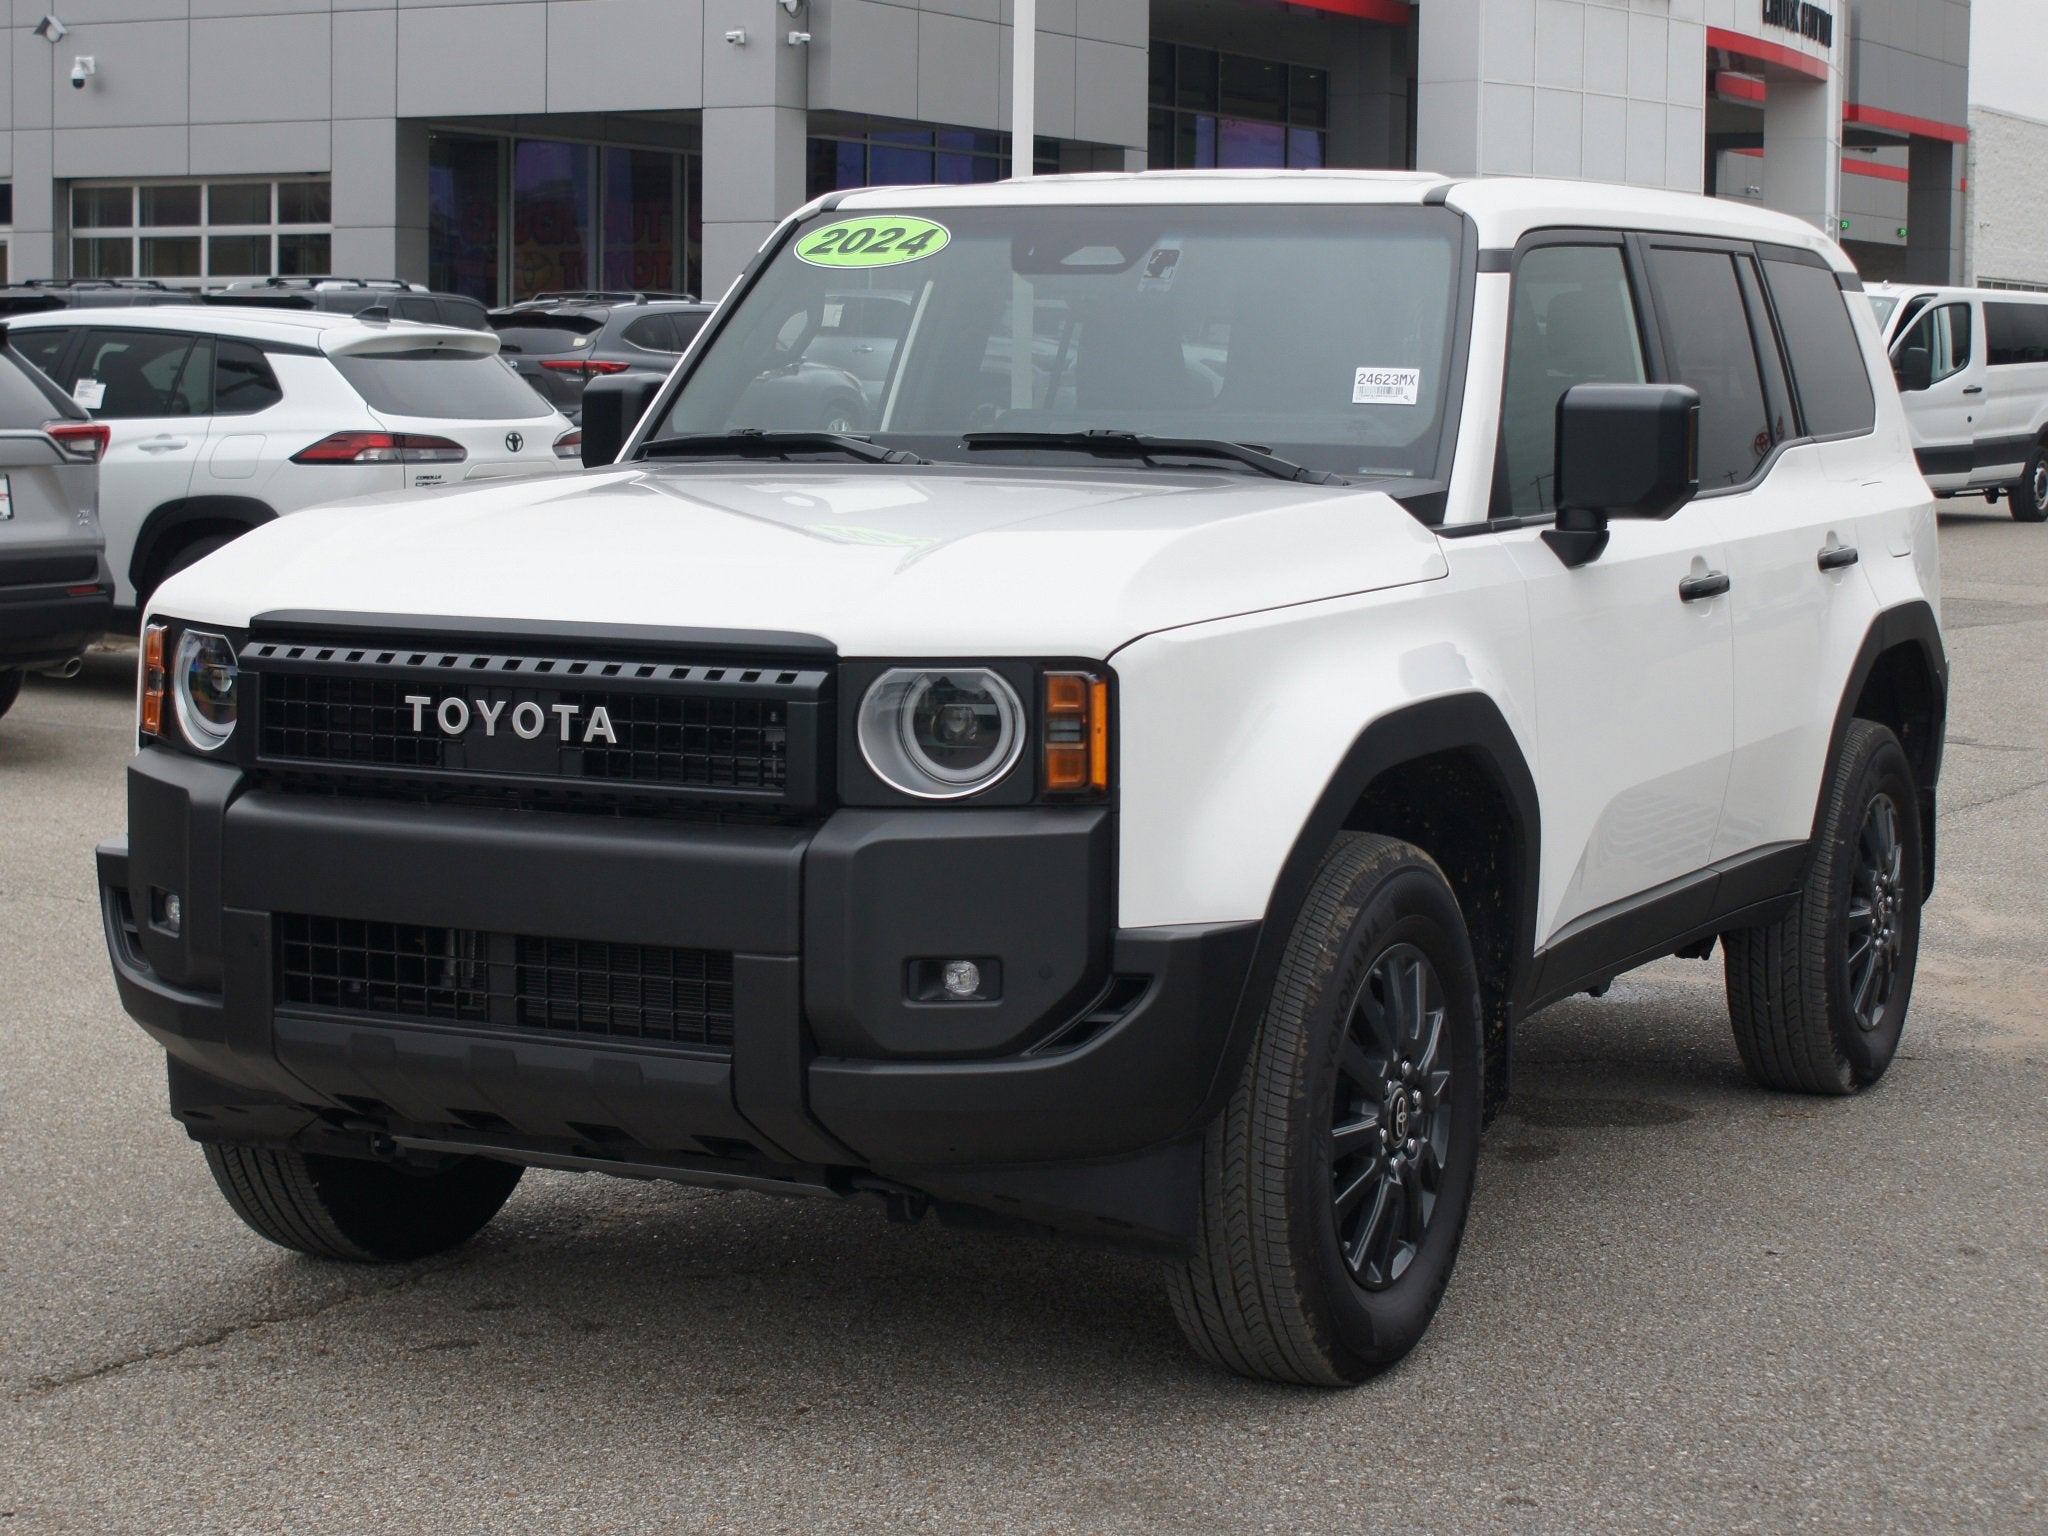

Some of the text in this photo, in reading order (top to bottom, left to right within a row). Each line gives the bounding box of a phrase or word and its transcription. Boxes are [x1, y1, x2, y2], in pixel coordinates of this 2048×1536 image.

[804, 227, 940, 256] 2024
[1357, 373, 1416, 386] 24623MX
[404, 695, 618, 744] TOYOTA
